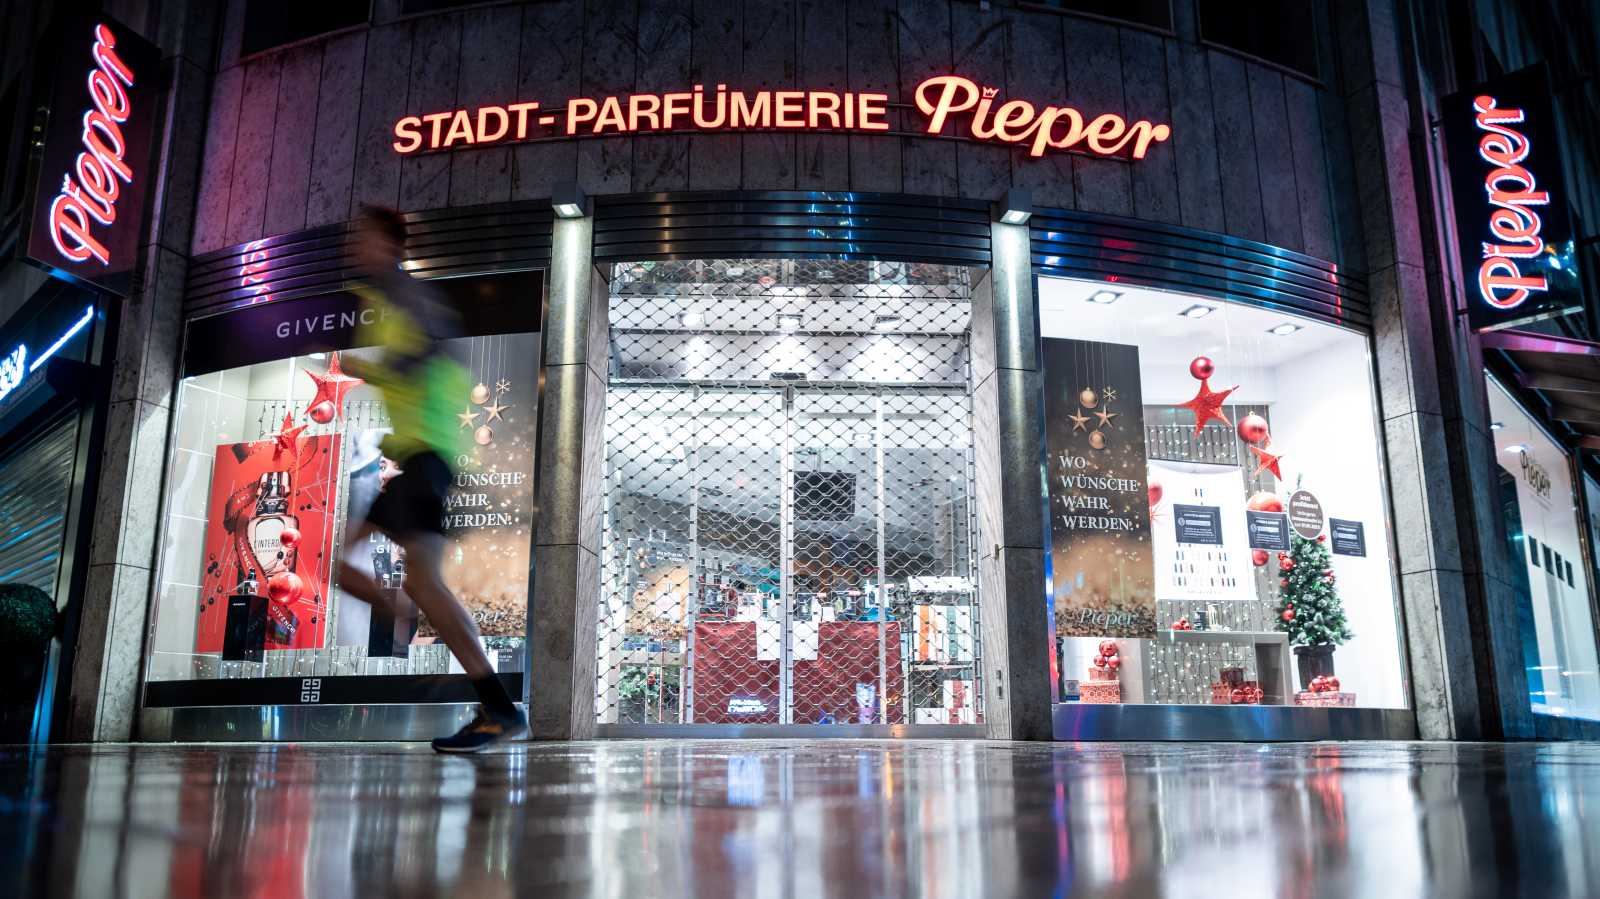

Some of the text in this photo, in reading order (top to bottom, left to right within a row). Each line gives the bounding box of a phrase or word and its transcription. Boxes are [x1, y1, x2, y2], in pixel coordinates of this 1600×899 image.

[566, 83, 889, 135] PARFÜMERIE
[914, 75, 1171, 159] Pieper
[50, 23, 134, 266] Pieper
[1473, 94, 1550, 310] Pieper
[276, 307, 393, 338] GIVENCH
[453, 454, 469, 467] O
[1059, 455, 1086, 469] WO
[450, 471, 523, 487] ÜNSCHE
[1060, 473, 1139, 492] WÜNSCHE
[441, 493, 489, 508] WAHR
[1061, 495, 1110, 510] WAHR
[441, 512, 513, 528] WERDEN.
[1062, 515, 1134, 531] WERDEN.
[1077, 607, 1140, 630] Pieper
